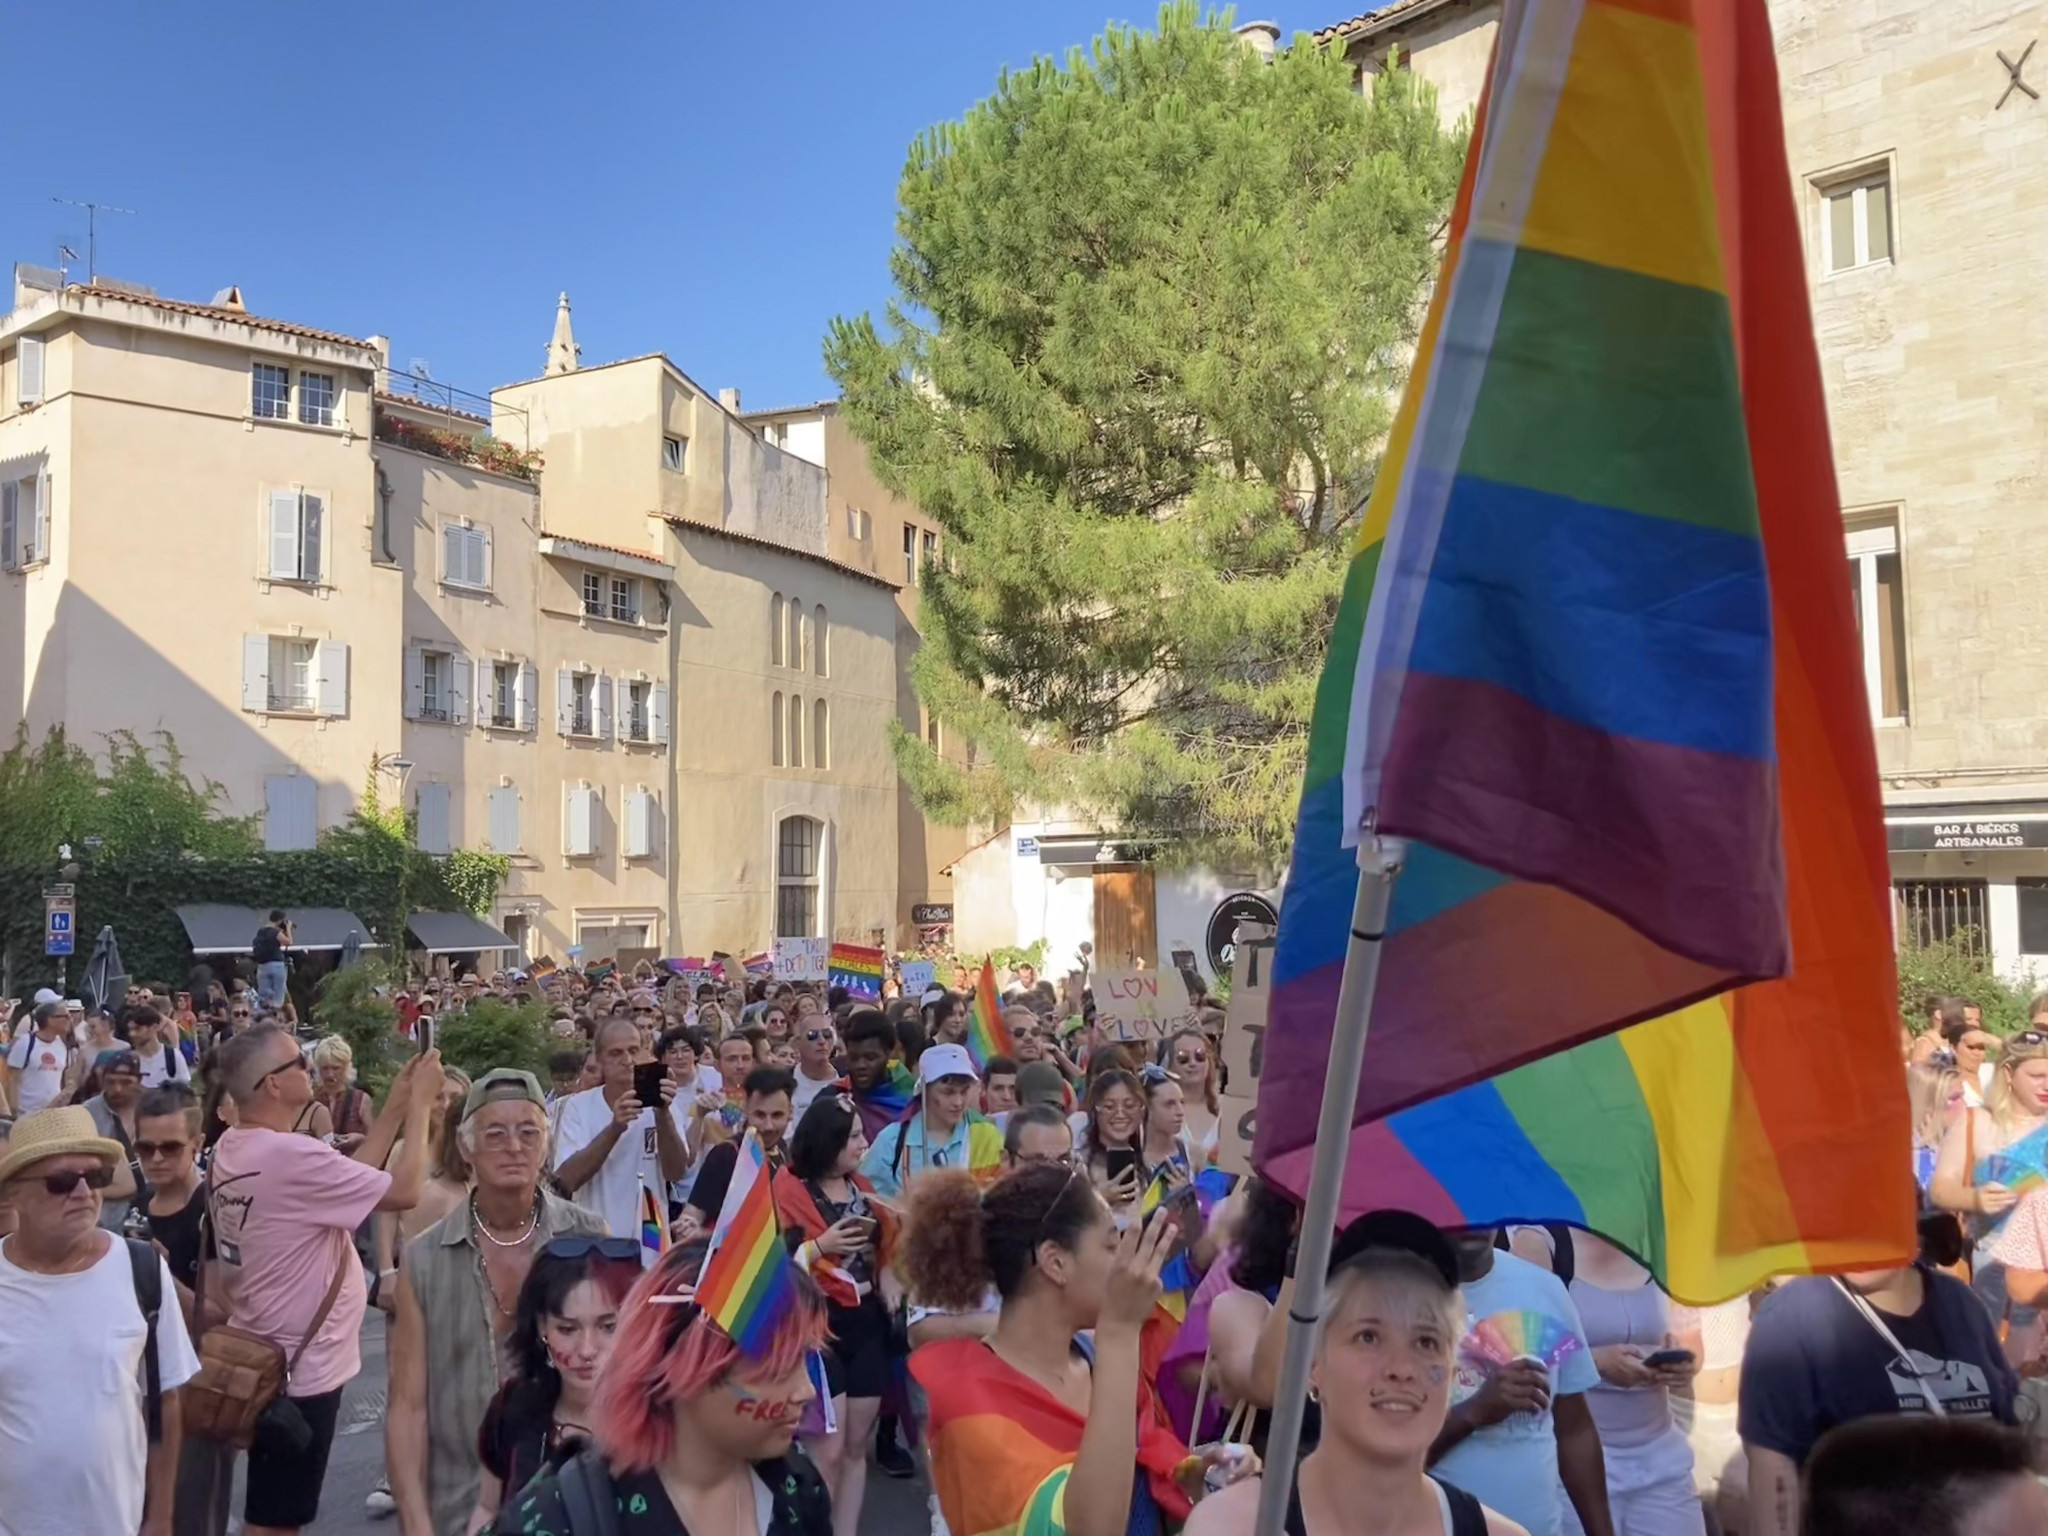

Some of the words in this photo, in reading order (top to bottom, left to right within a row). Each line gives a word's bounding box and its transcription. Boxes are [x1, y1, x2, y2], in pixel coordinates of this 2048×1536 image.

[1934, 825, 1961, 835] BAR
[1963, 823, 1974, 834] À
[1976, 822, 2020, 834] BIÈRES
[1934, 836, 2024, 848] ARTISANALES
